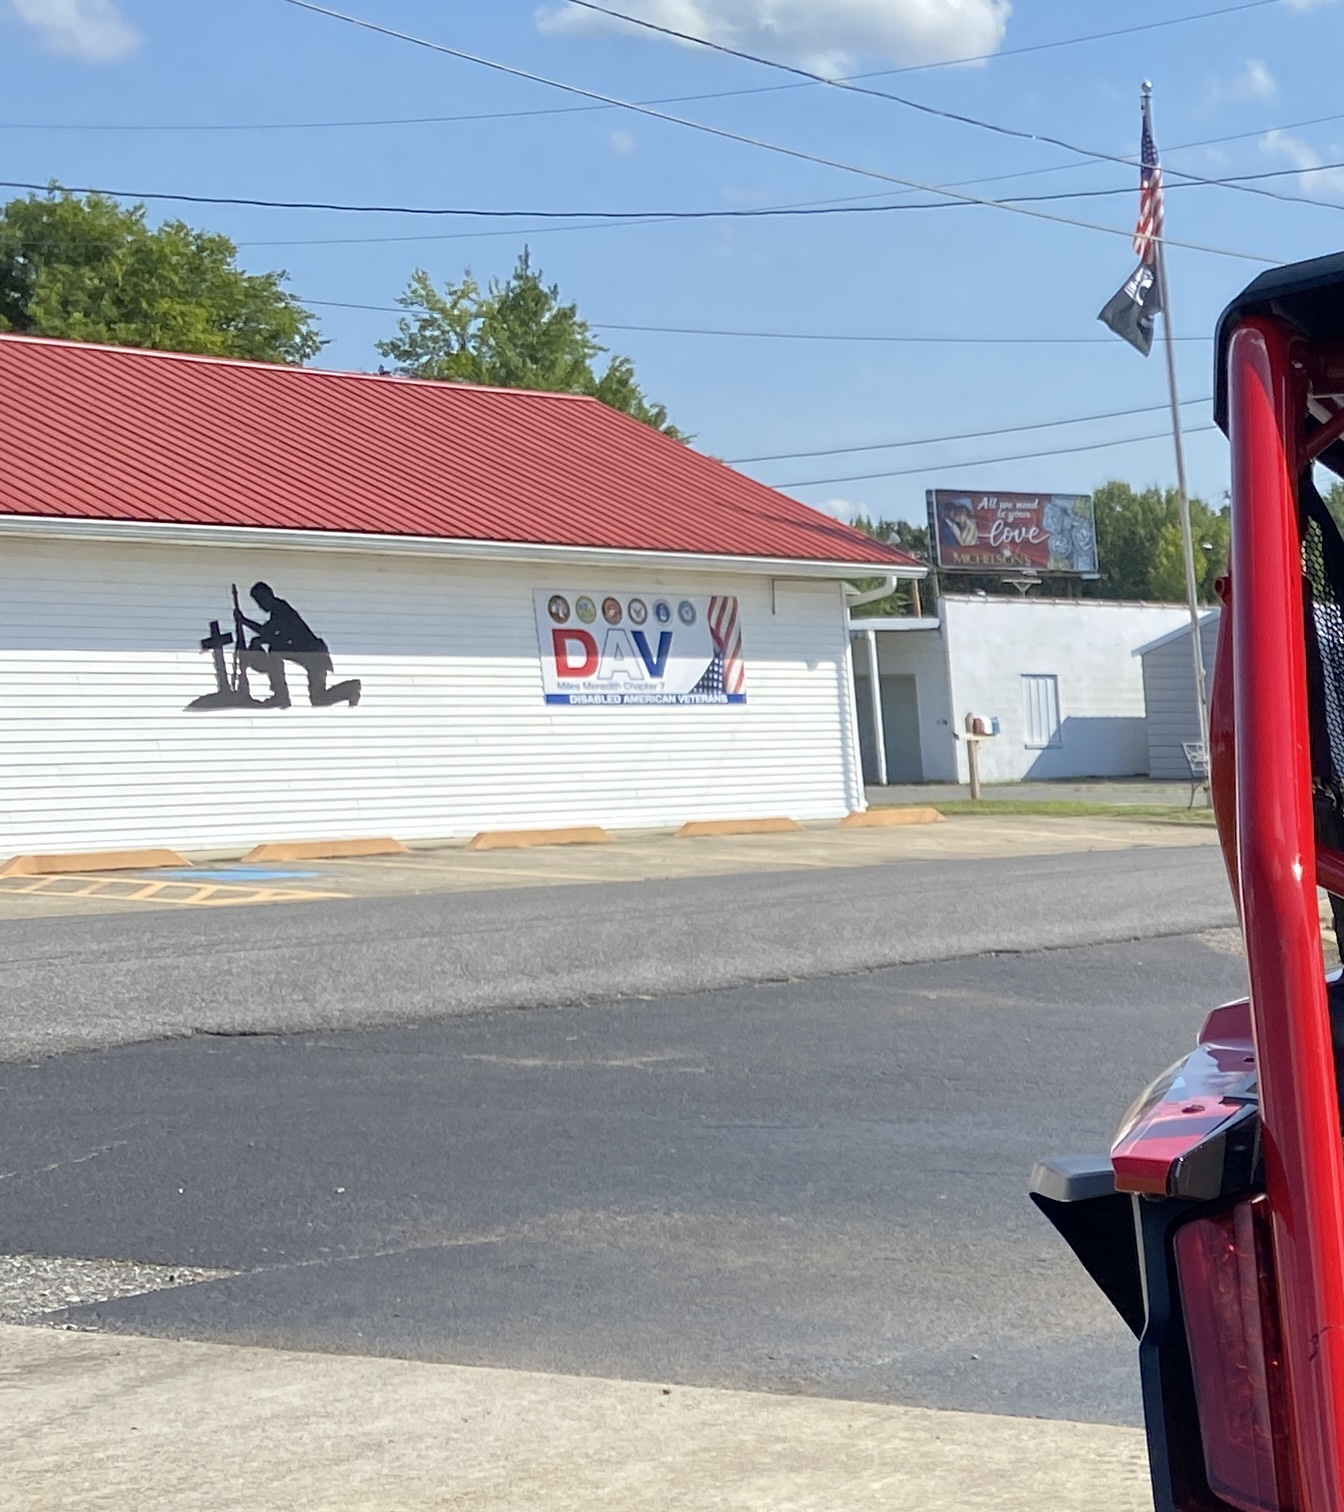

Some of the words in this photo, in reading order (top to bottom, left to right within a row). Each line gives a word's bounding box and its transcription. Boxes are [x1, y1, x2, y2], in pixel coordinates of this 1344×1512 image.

[977, 497, 997, 510] All
[978, 520, 1050, 547] love
[552, 628, 673, 681] DAV
[557, 682, 580, 691] Miles
[582, 682, 622, 691] Meredith
[624, 682, 658, 692] Chapter
[569, 694, 622, 705] DISABLED
[623, 694, 676, 705] AMERICAN
[678, 694, 729, 705] VETERANS
